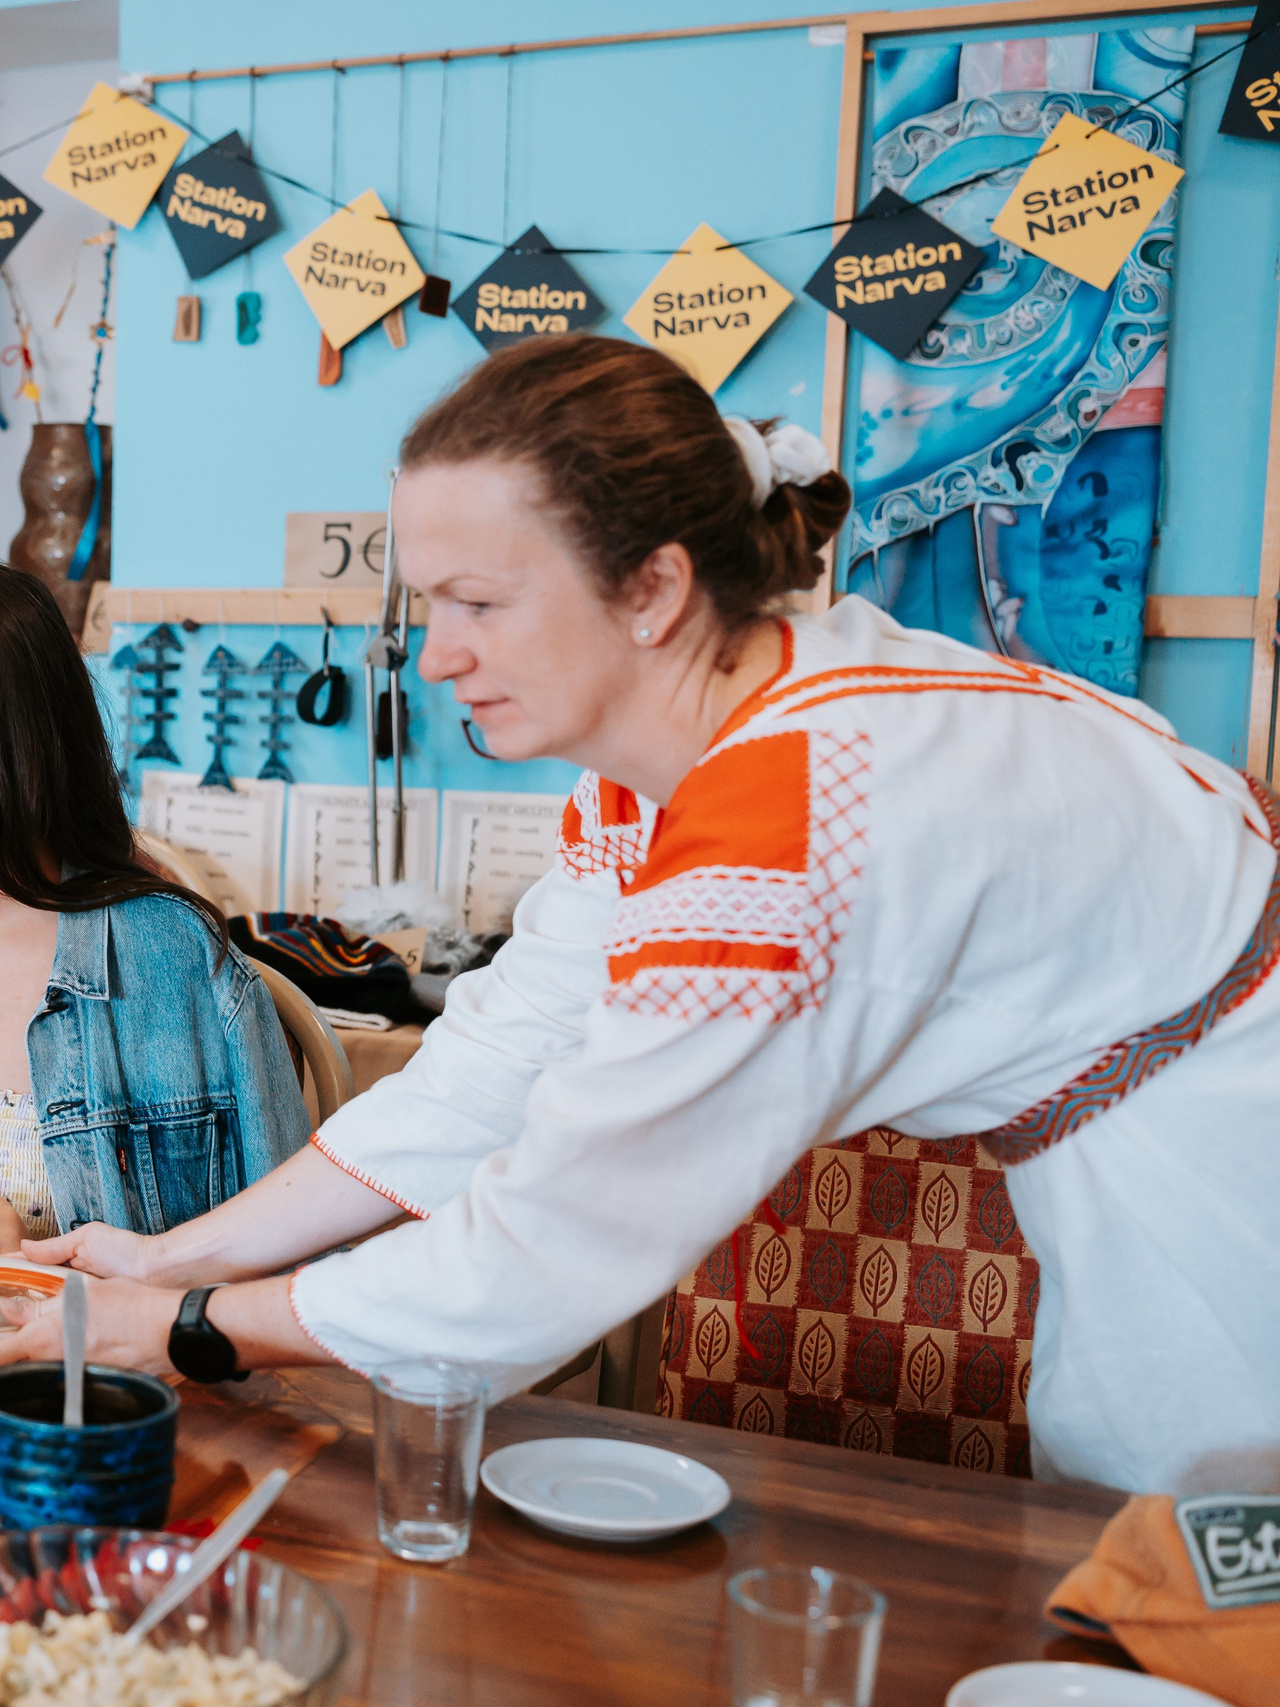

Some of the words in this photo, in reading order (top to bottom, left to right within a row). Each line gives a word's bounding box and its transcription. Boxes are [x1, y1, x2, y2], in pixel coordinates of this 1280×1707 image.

[1246, 70, 1280, 107] S
[67, 125, 168, 167] Station
[70, 151, 157, 188] Narva
[173, 172, 267, 222] Station
[1022, 162, 1154, 215] Station
[166, 194, 246, 240] Narva
[1026, 194, 1140, 242] Narva
[310, 242, 406, 276] Station
[833, 241, 963, 283] Station
[304, 265, 387, 297] Narva
[477, 282, 587, 311] Station
[653, 281, 766, 314] Station
[834, 268, 946, 309] Narva
[475, 307, 569, 334] Narva
[653, 310, 751, 339] Narva
